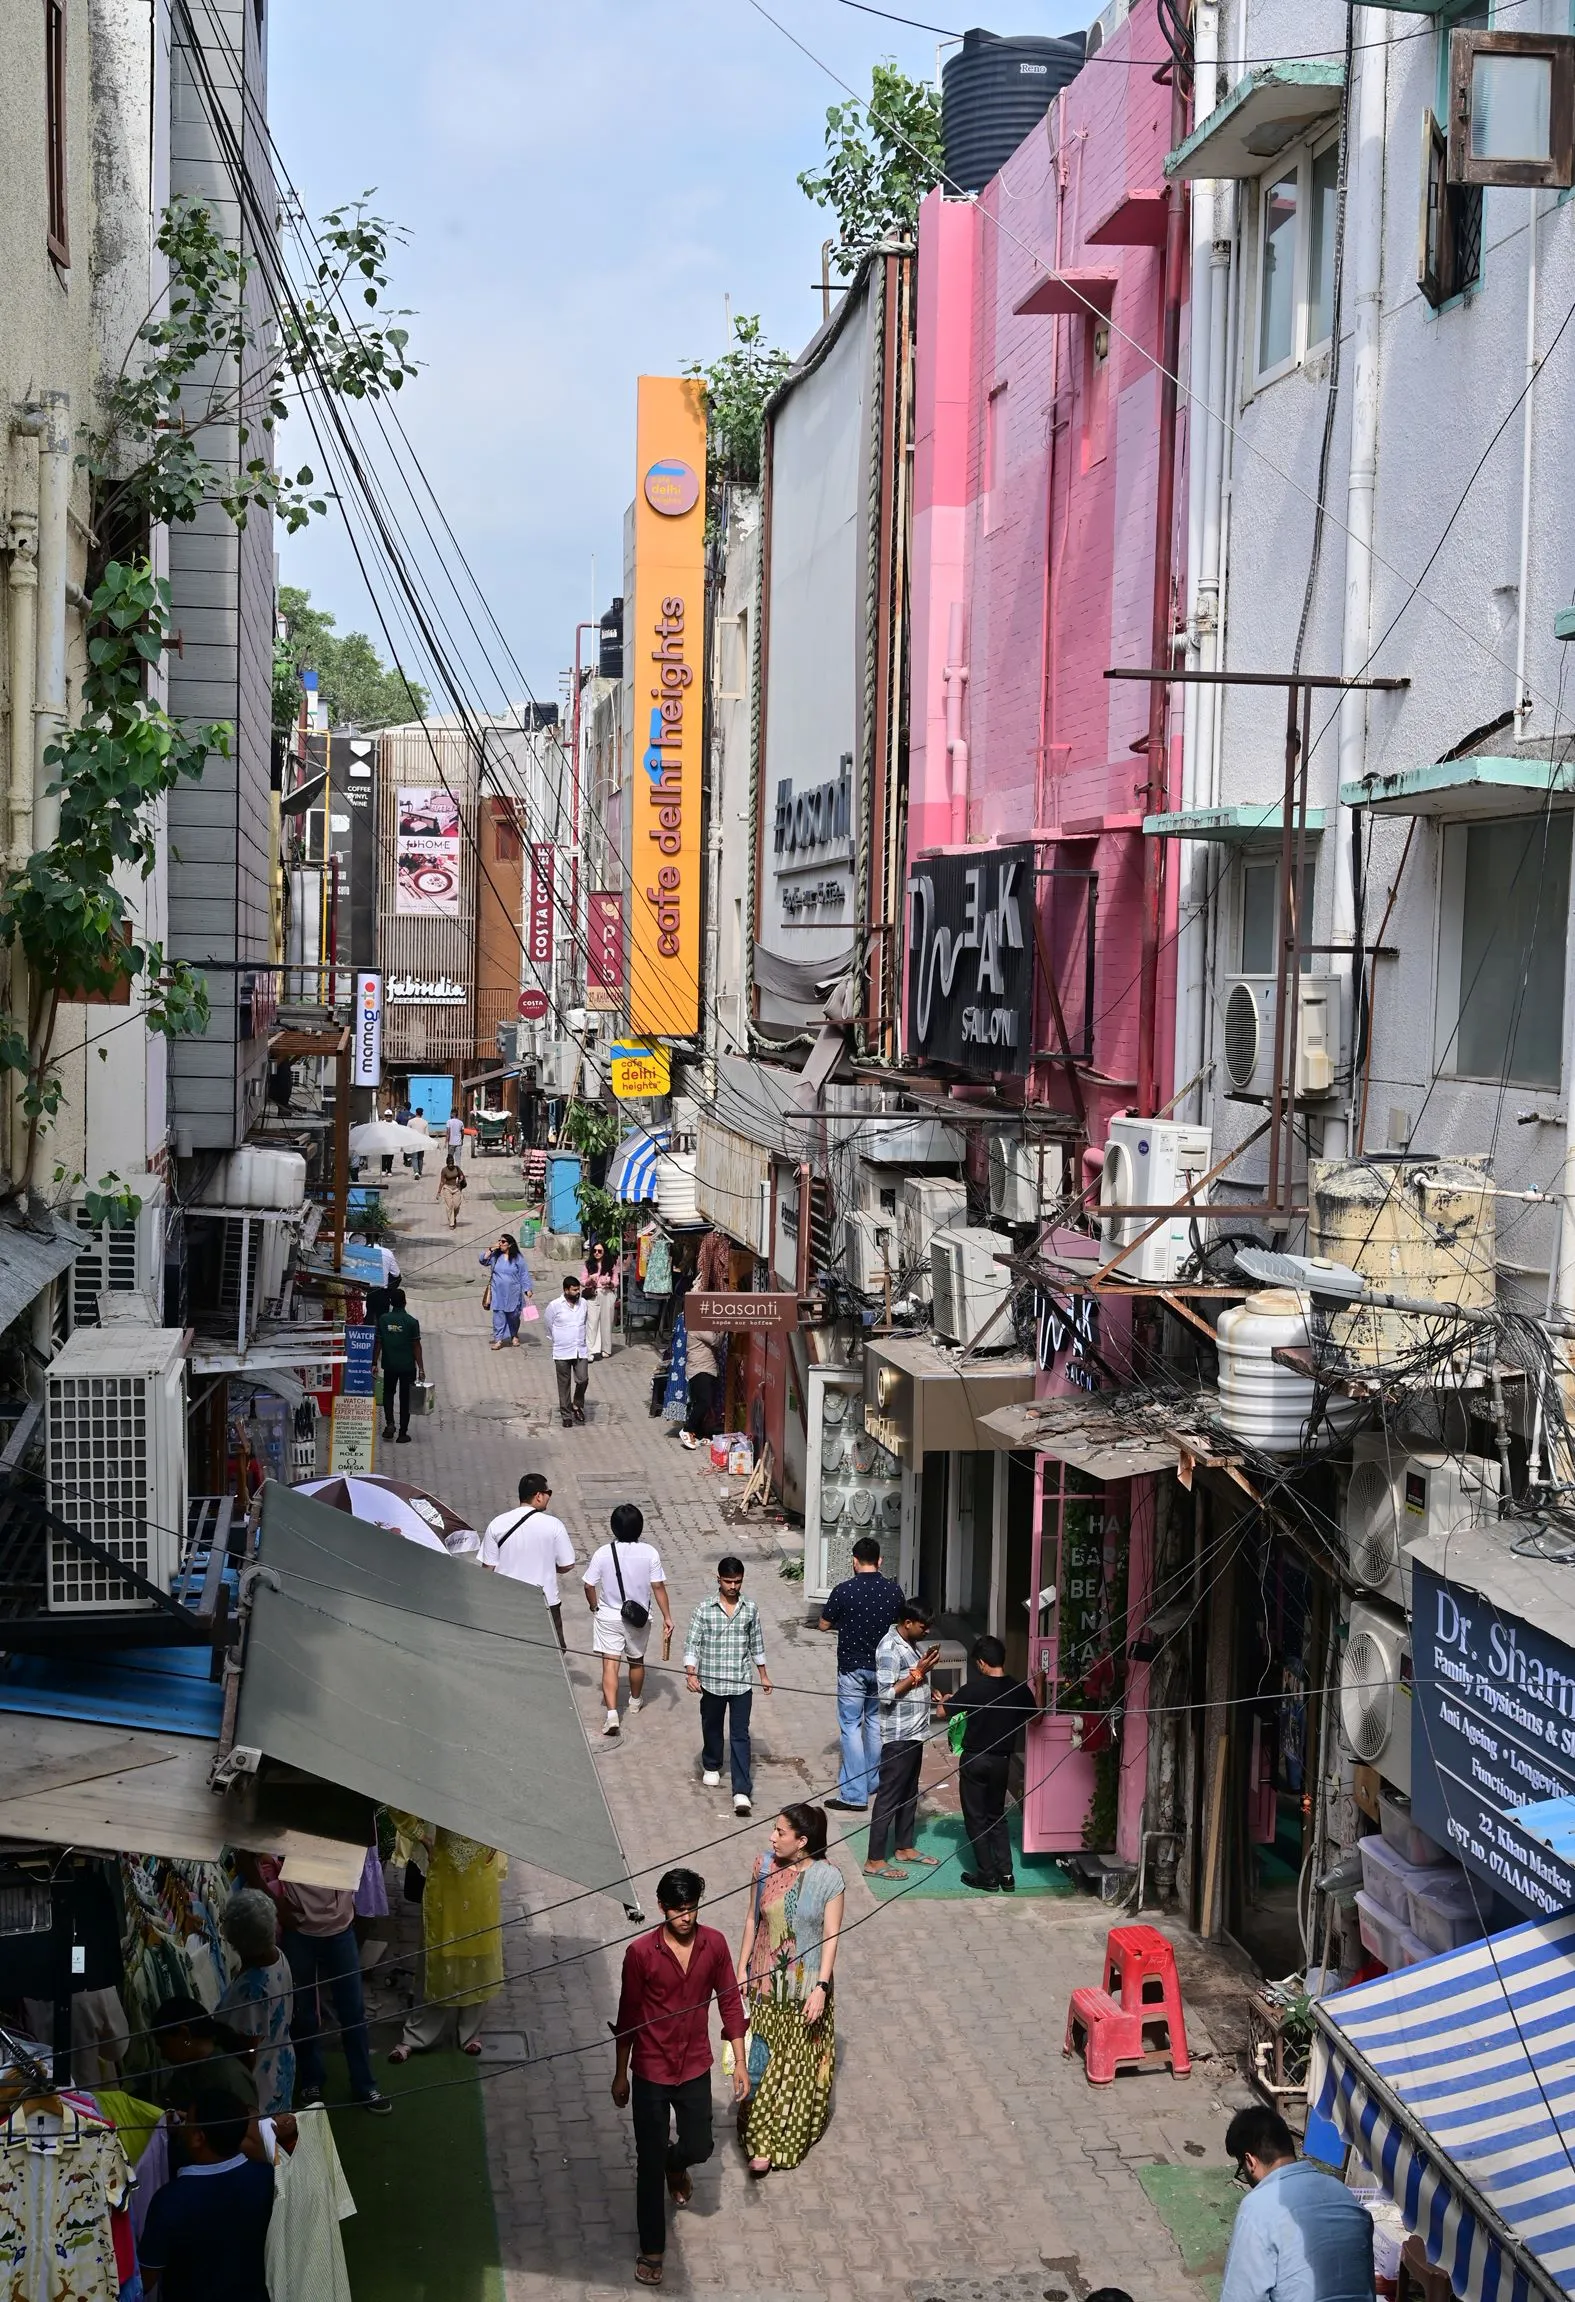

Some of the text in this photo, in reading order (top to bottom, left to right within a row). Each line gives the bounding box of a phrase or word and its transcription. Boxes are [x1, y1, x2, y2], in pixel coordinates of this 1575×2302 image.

[1020, 63, 1048, 74] Reno
[651, 484, 681, 495] delhi
[646, 596, 693, 957] cafe delhi heights
[535, 847, 550, 958] COSTA COFFEE
[386, 975, 467, 1003] fabindia
[361, 982, 380, 1073] mamagoto
[961, 1006, 1019, 1046] SALON
[621, 1058, 643, 1067] cafe
[621, 1067, 656, 1080] delhi
[699, 1300, 778, 1315] #basanti
[1435, 1589, 1477, 1660] Dr.
[1434, 1646, 1474, 1696] Family
[1475, 1673, 1543, 1737] Physicians
[1545, 1721, 1558, 1747] &
[1439, 1701, 1460, 1731] Anti
[1461, 1716, 1498, 1761] Ageing
[1471, 1757, 1526, 1808] Functional
[1446, 1818, 1470, 1848] GST
[1470, 1839, 1487, 1864] no.
[1478, 1812, 1572, 1899] 22, Khan Market
